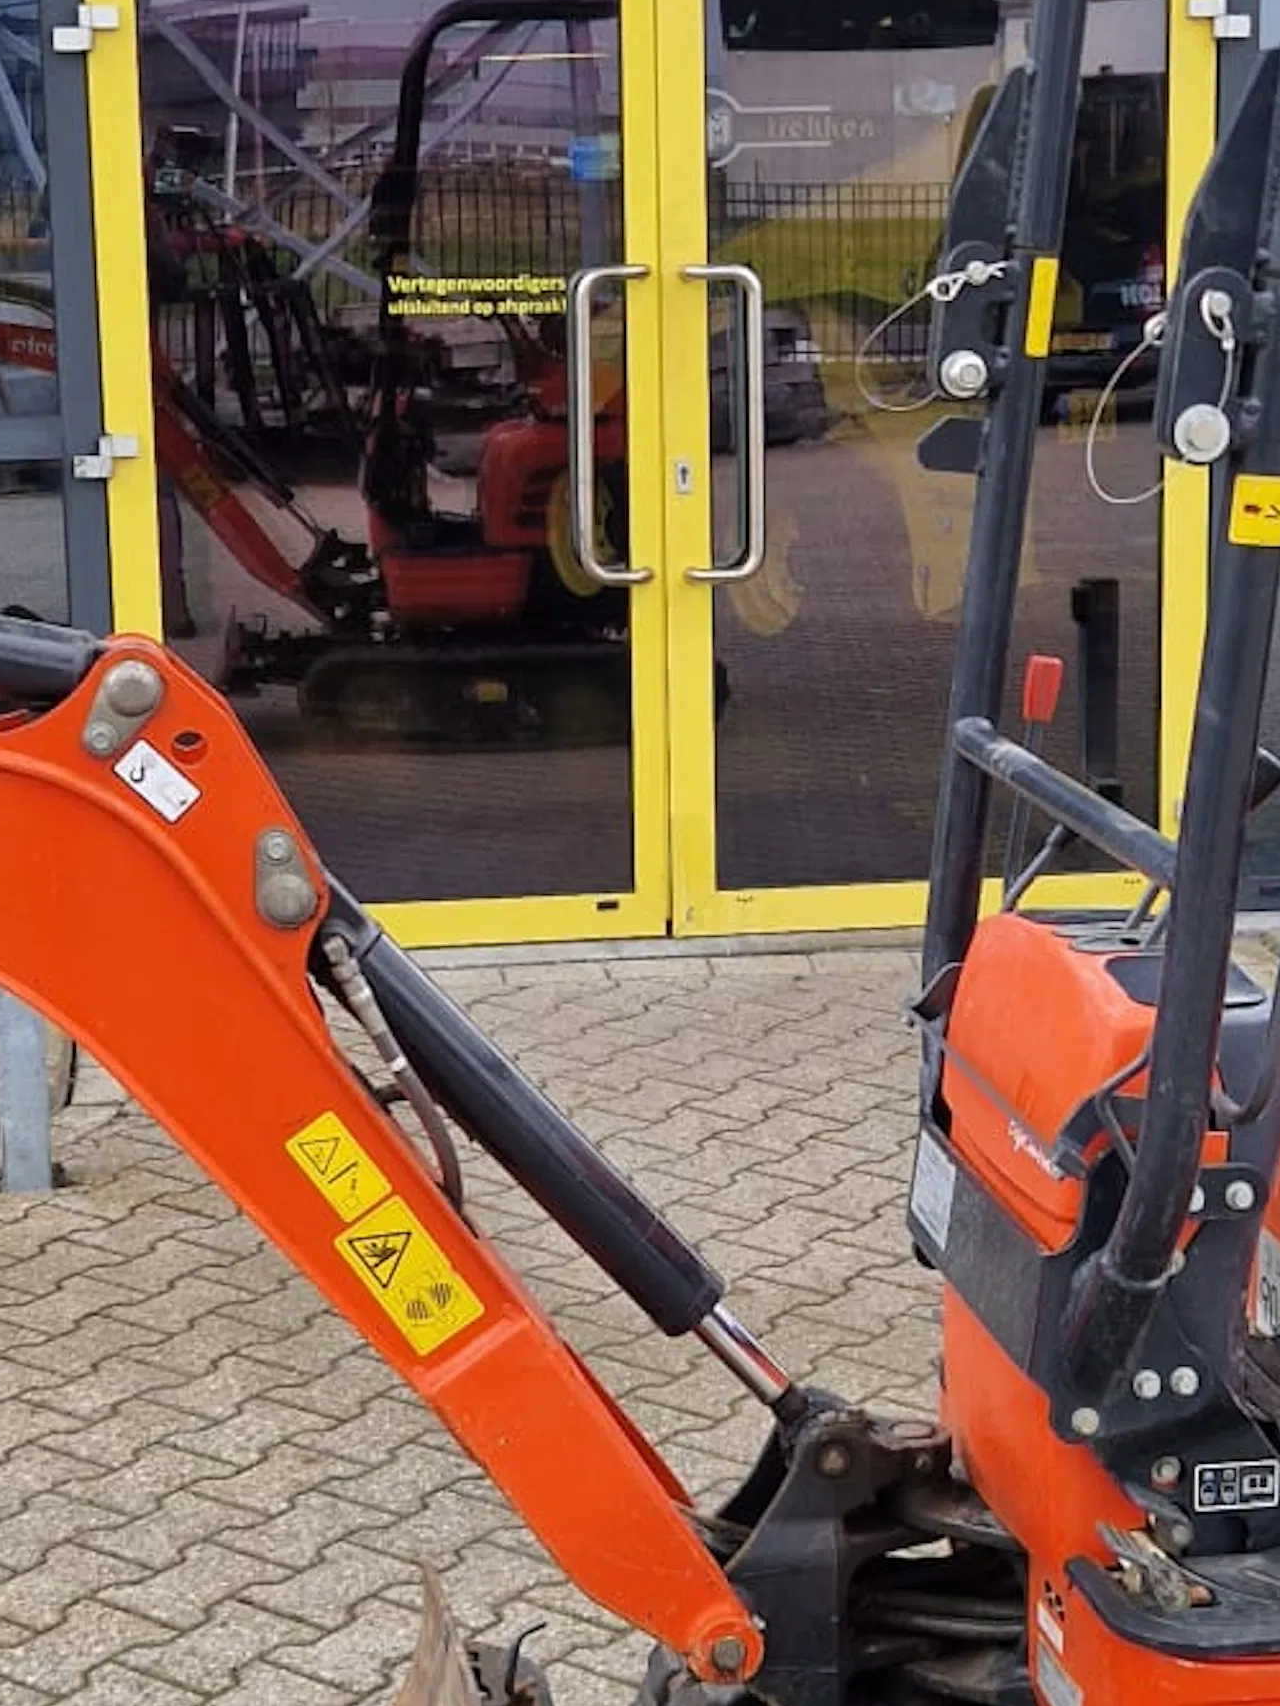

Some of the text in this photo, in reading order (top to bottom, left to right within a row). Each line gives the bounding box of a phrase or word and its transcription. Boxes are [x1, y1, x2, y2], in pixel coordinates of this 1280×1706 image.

[387, 274, 566, 296] Vertegenwoordigers
[387, 299, 469, 315] uitsluitend
[473, 303, 494, 317] op
